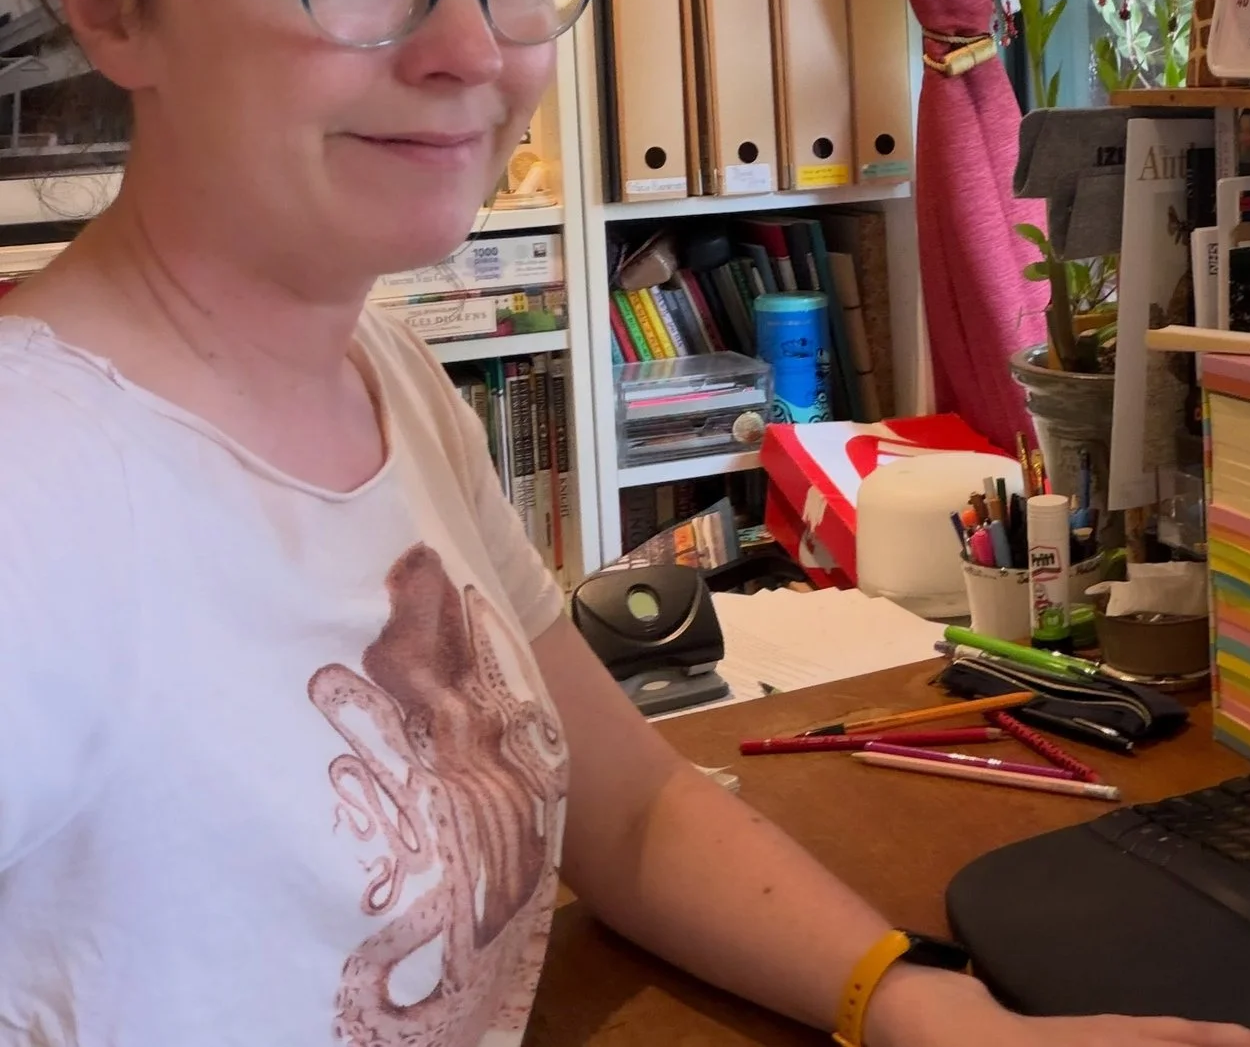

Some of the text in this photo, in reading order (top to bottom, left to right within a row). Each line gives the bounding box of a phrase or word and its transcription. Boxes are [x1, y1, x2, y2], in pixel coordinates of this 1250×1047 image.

[472, 246, 499, 258] 1000
[559, 477, 571, 518] KNIGHT
[1031, 553, 1056, 567] Pritt
